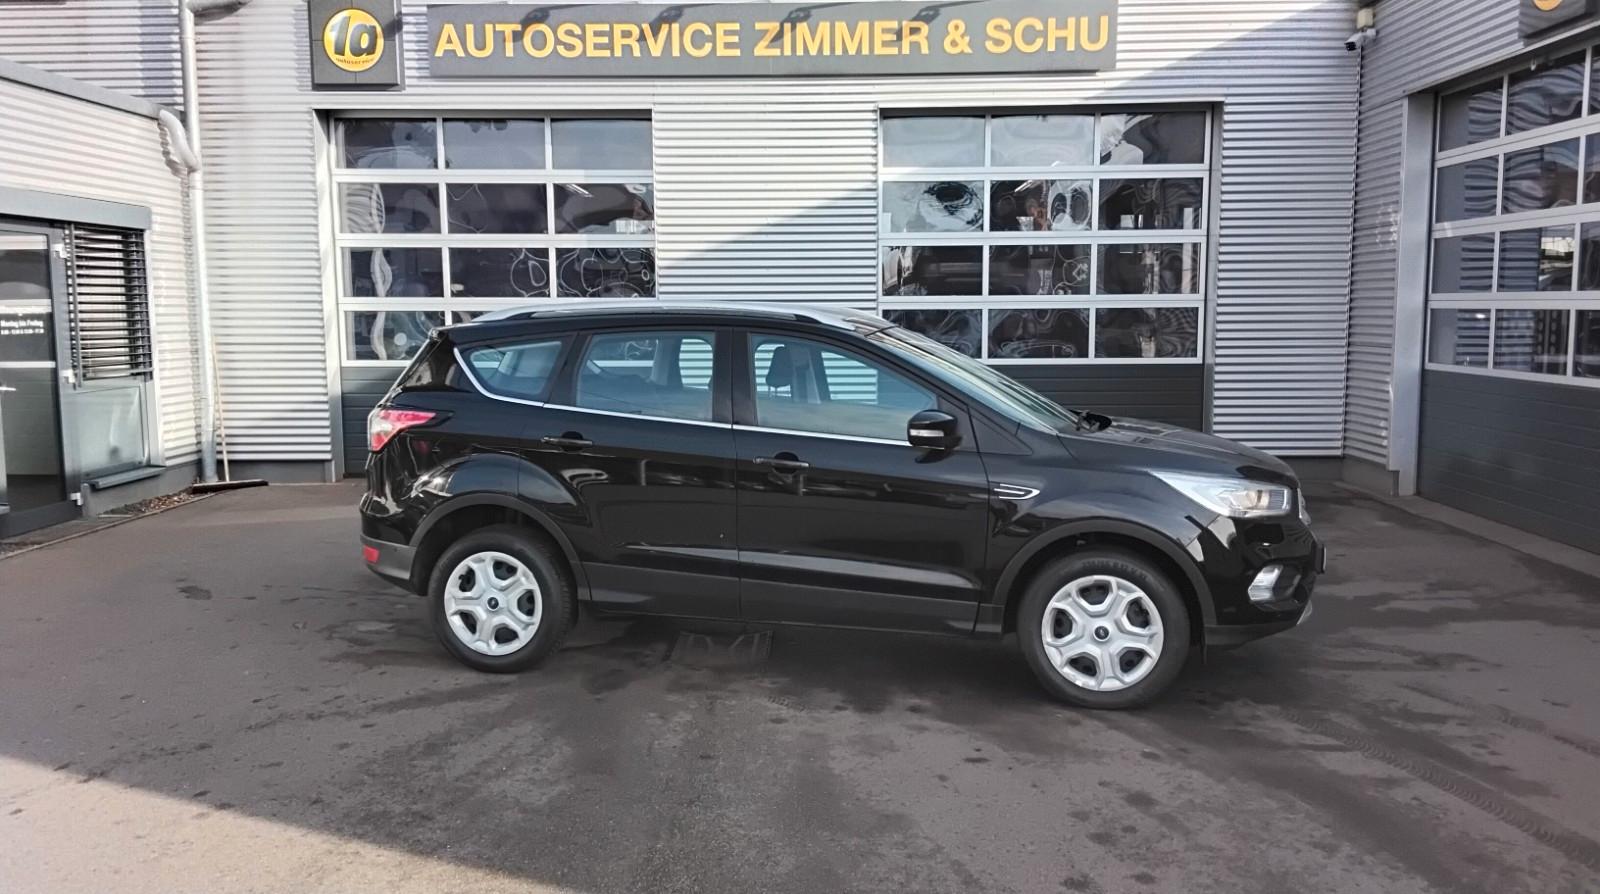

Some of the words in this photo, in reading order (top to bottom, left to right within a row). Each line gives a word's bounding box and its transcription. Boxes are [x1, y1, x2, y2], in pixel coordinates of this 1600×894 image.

[434, 22, 741, 58] AUTOSERVICE
[753, 19, 930, 57] ZIMMER
[943, 18, 973, 55] &
[984, 14, 1109, 54] SCHU
